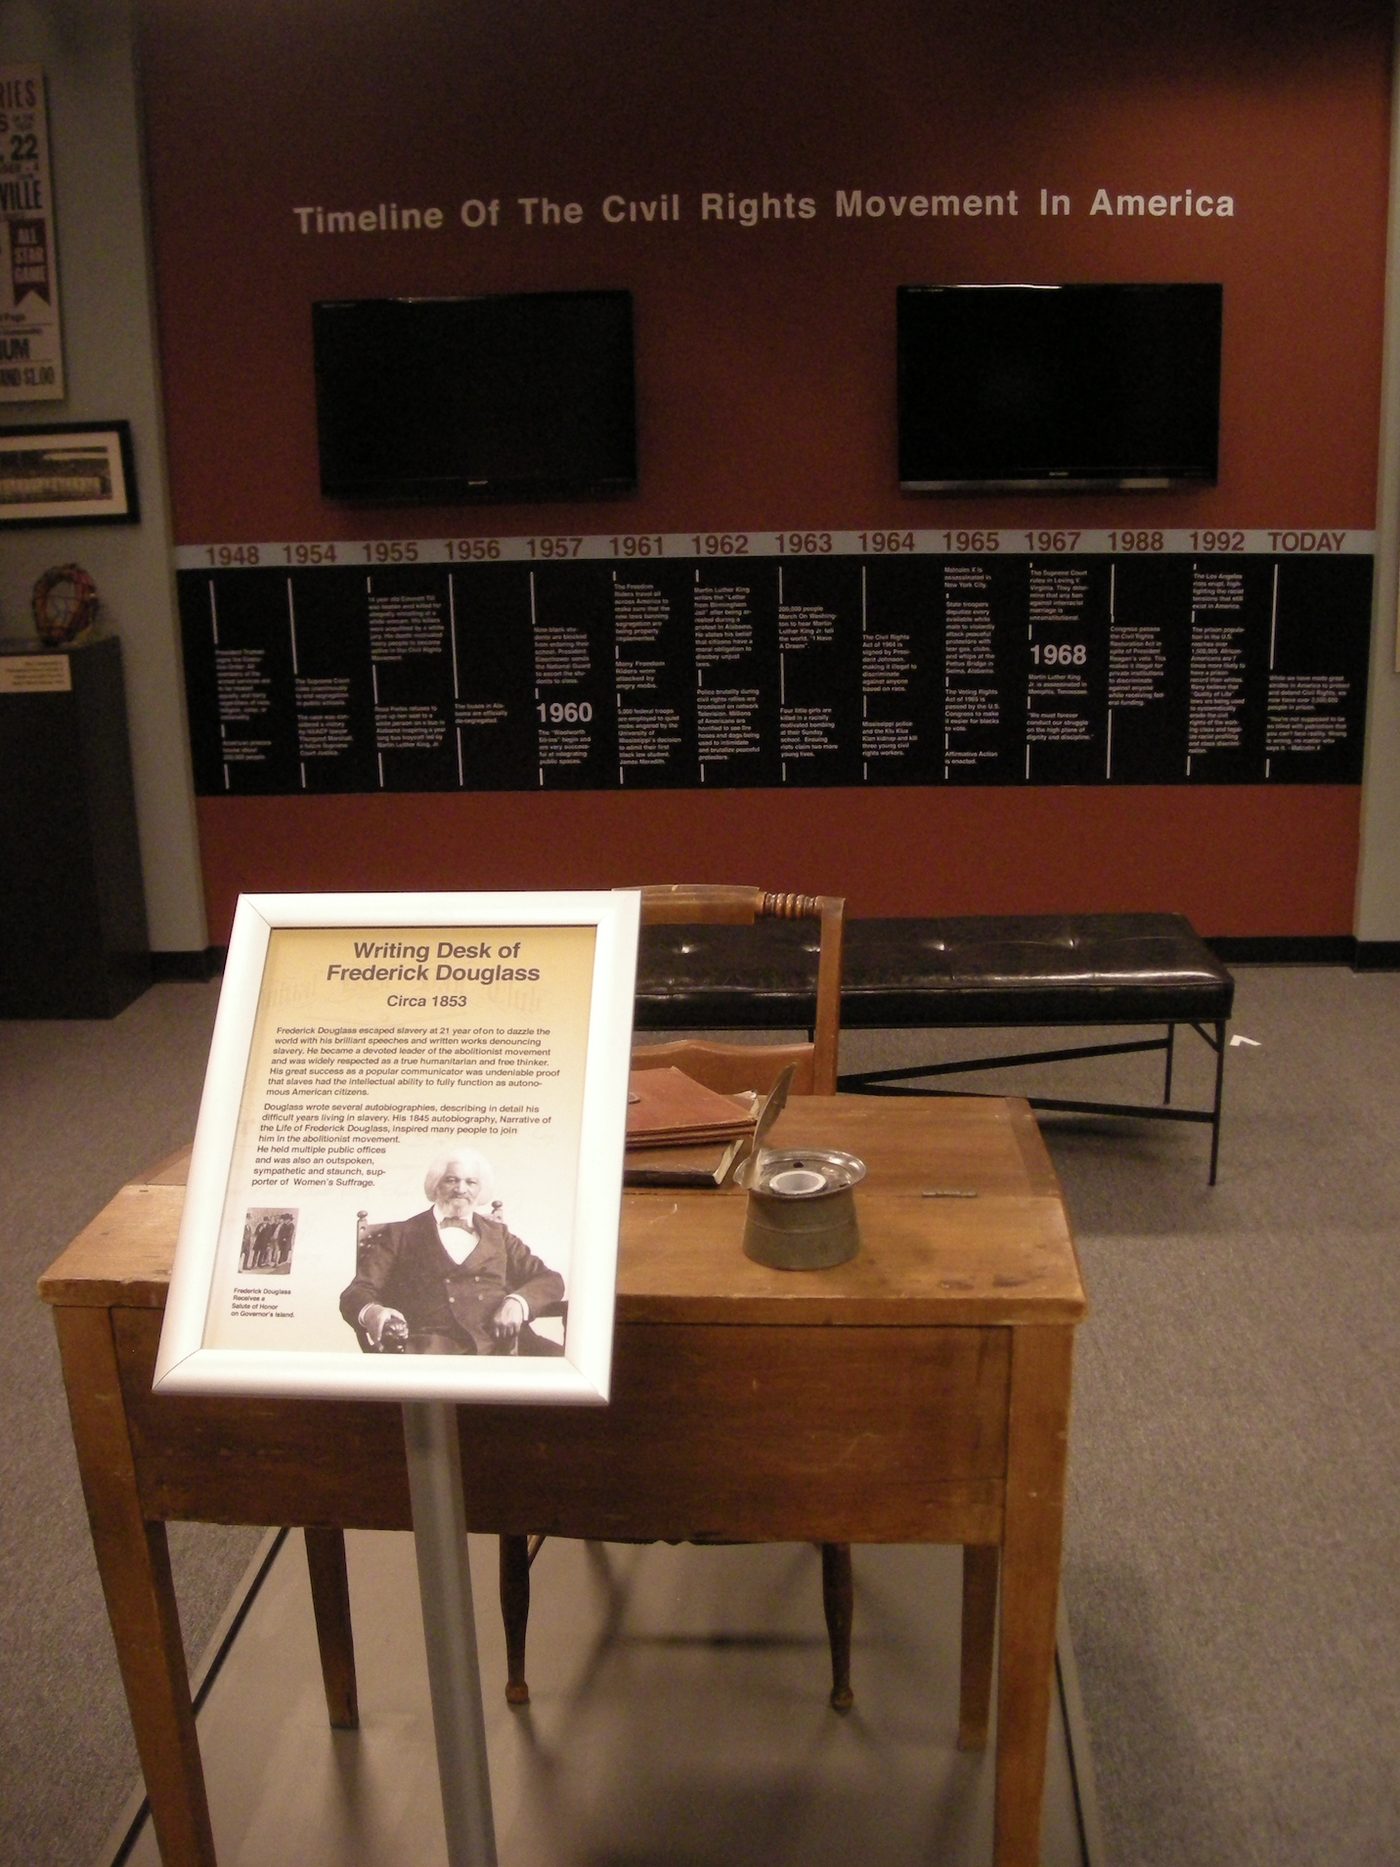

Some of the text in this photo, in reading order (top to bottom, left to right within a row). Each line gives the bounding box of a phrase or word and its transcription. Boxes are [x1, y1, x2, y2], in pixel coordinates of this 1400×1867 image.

[293, 189, 1235, 234] Timeline Of The Civil Rights Movement In America
[206, 531, 1347, 566] 1948 1954 1955 1956 1957 1961 1962 1963 1964 1965 1967 1988 1992 TODAY
[1030, 644, 1087, 666] 1968
[536, 702, 593, 723] 1960
[353, 942, 521, 963] Writing Desk of
[326, 964, 541, 985] Frederick Douglass
[387, 995, 468, 1007] Circa 1853
[276, 1026, 316, 1034] Frederick
[317, 1026, 358, 1036] Douglass
[358, 1026, 395, 1036] escaped
[397, 1027, 428, 1036] slavery
[452, 1029, 471, 1037] year
[496, 1027, 506, 1035] to
[507, 1027, 535, 1035] dazzle
[536, 1027, 551, 1035] the
[300, 1036, 318, 1044] with
[320, 1036, 333, 1044] his
[334, 1036, 367, 1044] brilliant
[368, 1036, 410, 1046] speeches
[460, 1037, 488, 1045] works
[489, 1037, 542, 1047] denouncing
[273, 1046, 305, 1056] slavery.
[307, 1046, 319, 1054] He
[427, 1047, 437, 1055] of
[438, 1047, 453, 1055] the
[454, 1047, 503, 1055] abolitionist
[505, 1047, 551, 1055] movement
[271, 1056, 288, 1064] and
[308, 1057, 335, 1066] widely
[337, 1057, 380, 1066] respected
[400, 1057, 419, 1065] true
[420, 1057, 478, 1065] humanitarian
[479, 1057, 496, 1065] and
[498, 1057, 515, 1065] free
[270, 1066, 284, 1074] His
[285, 1067, 308, 1076] great
[365, 1067, 399, 1077] popular
[485, 1068, 535, 1076] undeniable
[535, 1068, 560, 1078] proof
[264, 1102, 304, 1112] Douglass
[306, 1102, 330, 1110] wrote
[365, 1103, 439, 1113] autobiographies,
[440, 1104, 487, 1114] describing
[489, 1104, 498, 1112] in
[499, 1104, 524, 1112] detail
[526, 1104, 540, 1112] his
[262, 1113, 294, 1121] difficult
[295, 1115, 319, 1123] years
[321, 1113, 345, 1123] living
[357, 1114, 390, 1124] slavery.
[392, 1114, 407, 1122] His
[410, 1114, 430, 1122] 1845
[432, 1114, 498, 1125] autobiography,
[500, 1115, 541, 1123] Narrative
[542, 1115, 552, 1123] of
[260, 1123, 275, 1131] the
[276, 1123, 293, 1131] Life
[305, 1124, 345, 1132] Frederick
[347, 1124, 391, 1134] Douglass,
[392, 1124, 429, 1134] inspired
[431, 1126, 455, 1135] many
[456, 1125, 488, 1135] people
[489, 1125, 499, 1133] to
[500, 1126, 518, 1135] join
[259, 1134, 401, 1143] him in the abolitionist movement.
[291, 1145, 326, 1155] multiple
[327, 1145, 355, 1155] public
[357, 1145, 387, 1153] offices
[293, 1156, 312, 1164] also
[326, 1156, 375, 1166] outspoken,
[253, 1167, 386, 1177] sympathetic and staunch, sup-
[251, 1177, 278, 1187] porter
[336, 1178, 376, 1188] Suffrage.
[263, 1288, 292, 1296] Douglass
